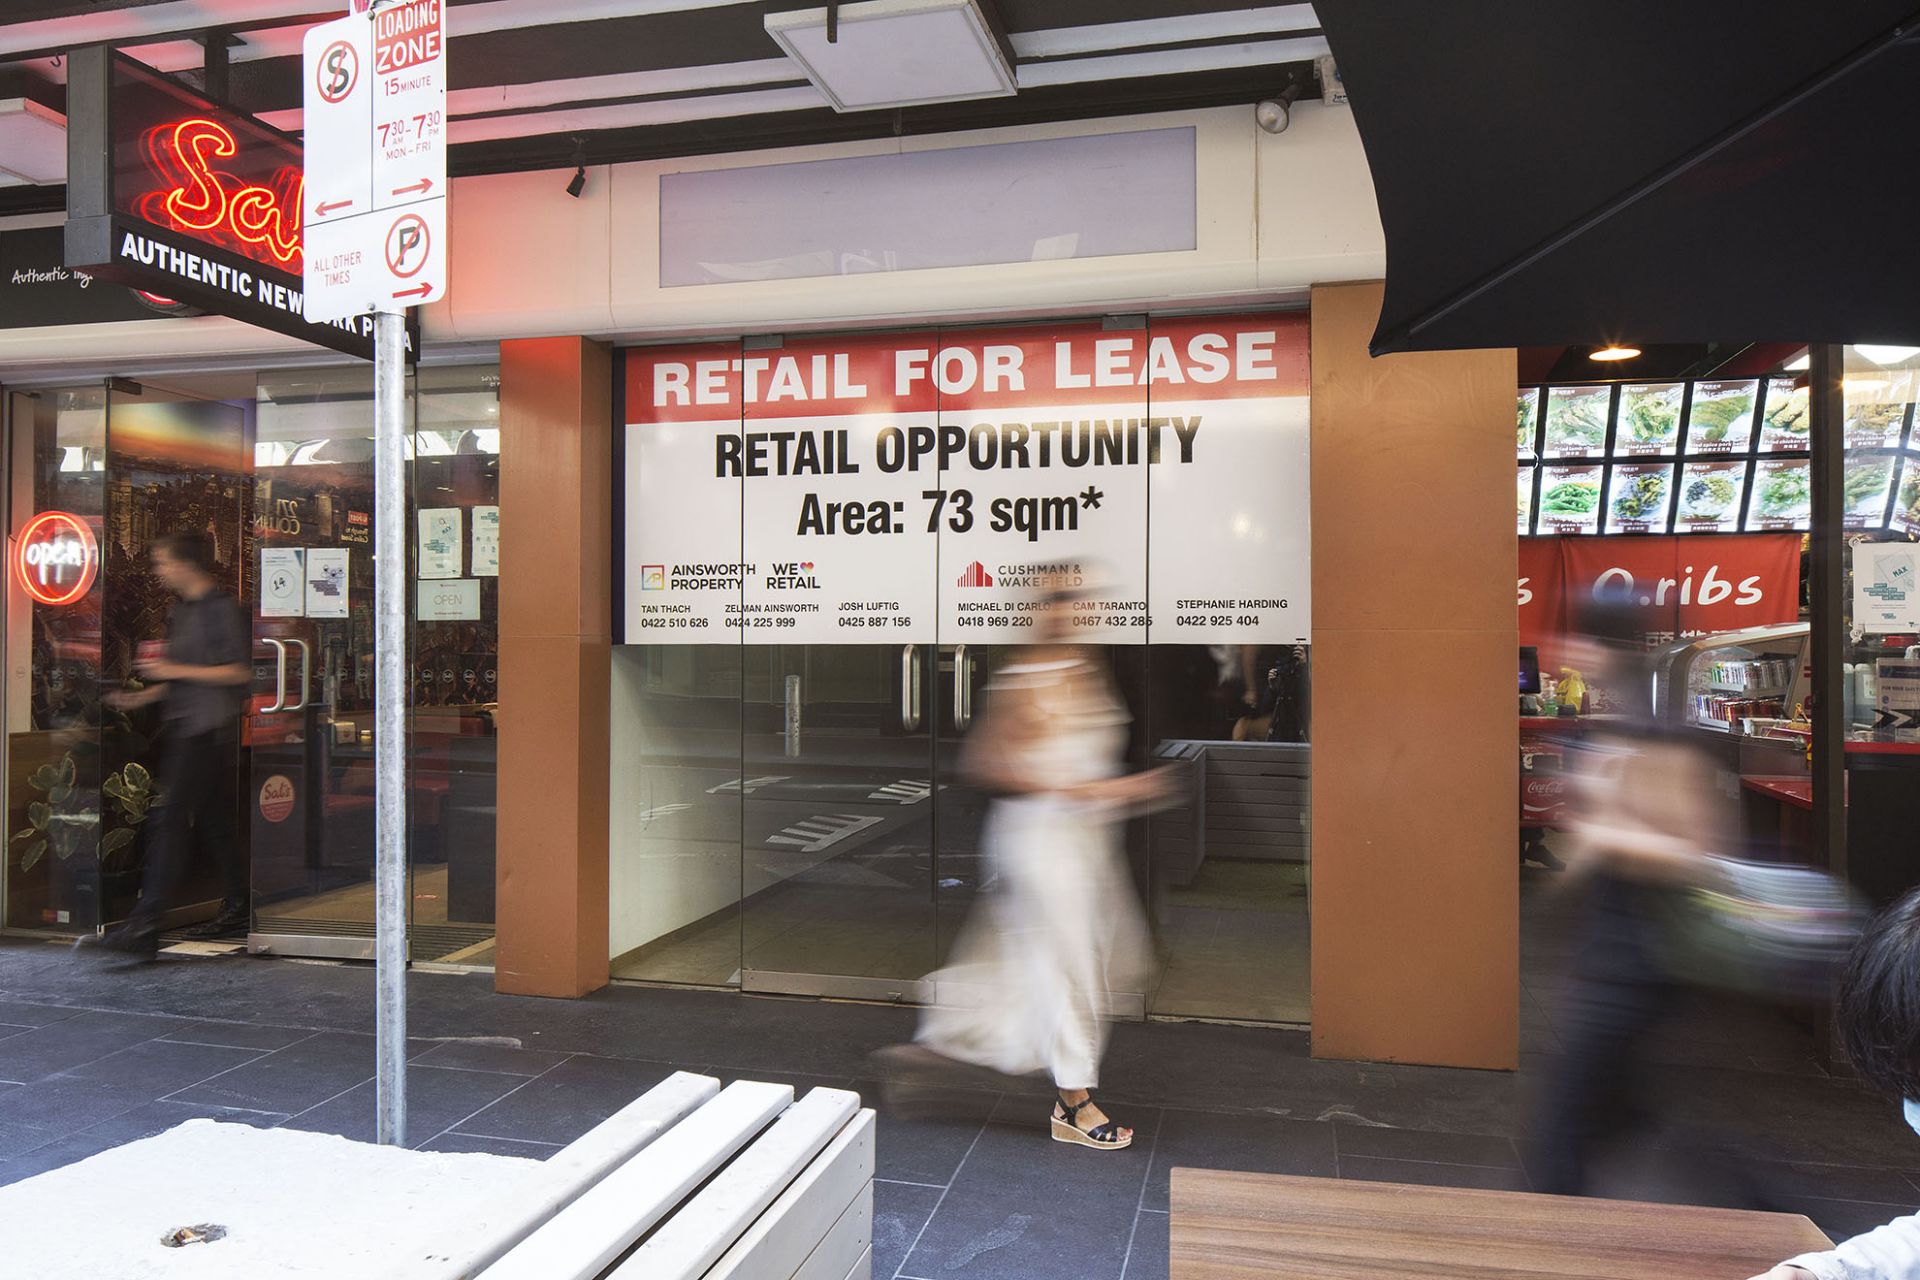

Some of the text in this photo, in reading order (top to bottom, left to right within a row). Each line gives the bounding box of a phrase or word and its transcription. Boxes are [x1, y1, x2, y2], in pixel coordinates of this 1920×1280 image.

[378, 0, 437, 40] LOADING
[377, 31, 439, 73] ZONE
[385, 75, 431, 96] 15 MINUTE
[314, 251, 362, 272] ALL OTHER
[12, 266, 69, 284] Authentic
[121, 232, 252, 298] AUTHENTIC
[258, 280, 304, 315] NEW
[325, 271, 350, 287] TIMES
[653, 331, 1277, 407] RETAIL FOR LEASE
[716, 415, 1202, 478] RETAIL OPPORTUNITY
[797, 493, 904, 535] Area:
[922, 489, 974, 534] 73
[671, 563, 756, 576] AINSWORTH
[772, 563, 798, 575] WE
[998, 564, 1082, 575] CUSHMAN &
[1892, 566, 1908, 577] MAX
[671, 578, 743, 590] PROPERTY
[766, 577, 821, 589] RETAIL
[998, 577, 1083, 587] WAKEFIELD
[433, 594, 462, 605] OPEN
[1176, 599, 1288, 609] STEPHANIE HARDING
[641, 605, 691, 614] TAN THACH
[725, 604, 819, 613] ZELMAN AINSWORTH
[838, 602, 899, 611] JOSH LUFTIG
[958, 602, 1050, 611] MICHAEL DI CARLO
[1072, 601, 1146, 611] CAM TARANTO
[641, 618, 709, 628] 0422 510 626
[725, 617, 796, 628] 0424 225 999
[838, 617, 911, 627] 0425 887 156
[958, 617, 1033, 627] 0418 969 220
[1072, 616, 1101, 626] 0467
[1105, 616, 1127, 626] 432
[1176, 615, 1259, 626] 0422 925 404
